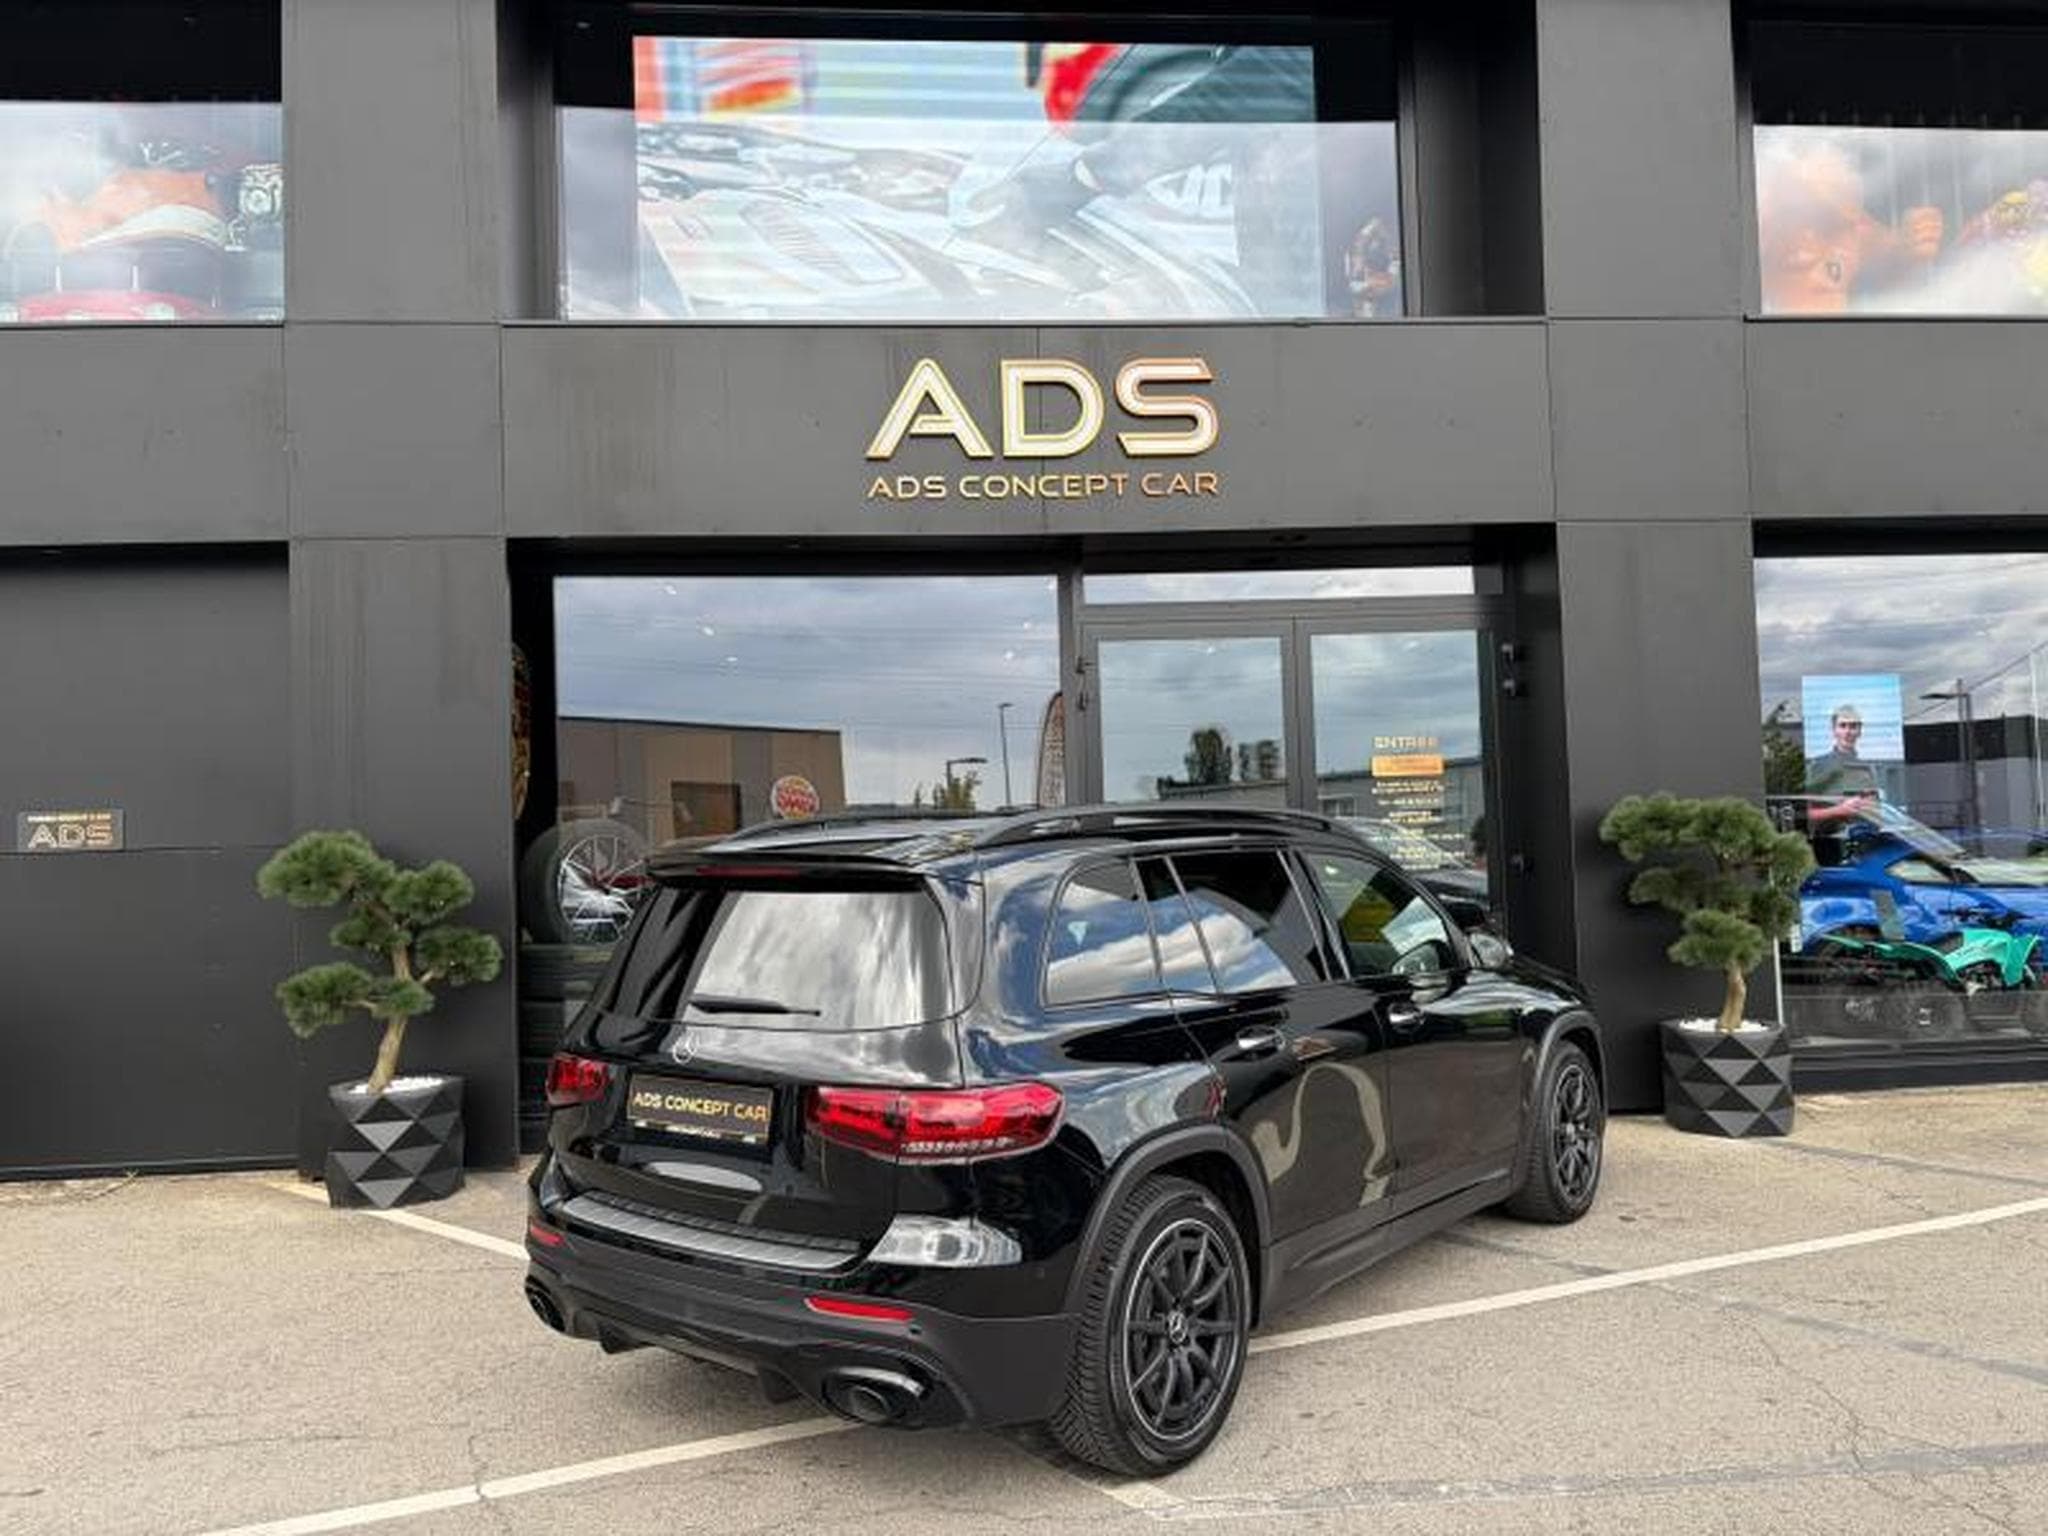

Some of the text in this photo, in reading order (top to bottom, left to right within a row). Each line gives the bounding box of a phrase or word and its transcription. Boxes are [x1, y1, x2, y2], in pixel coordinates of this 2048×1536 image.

[865, 357, 1219, 458] ADS
[867, 471, 1220, 499] ADS CONCEPT CAR
[27, 823, 113, 849] ADS
[633, 1092, 767, 1121] ADS CONCEPT CAR
